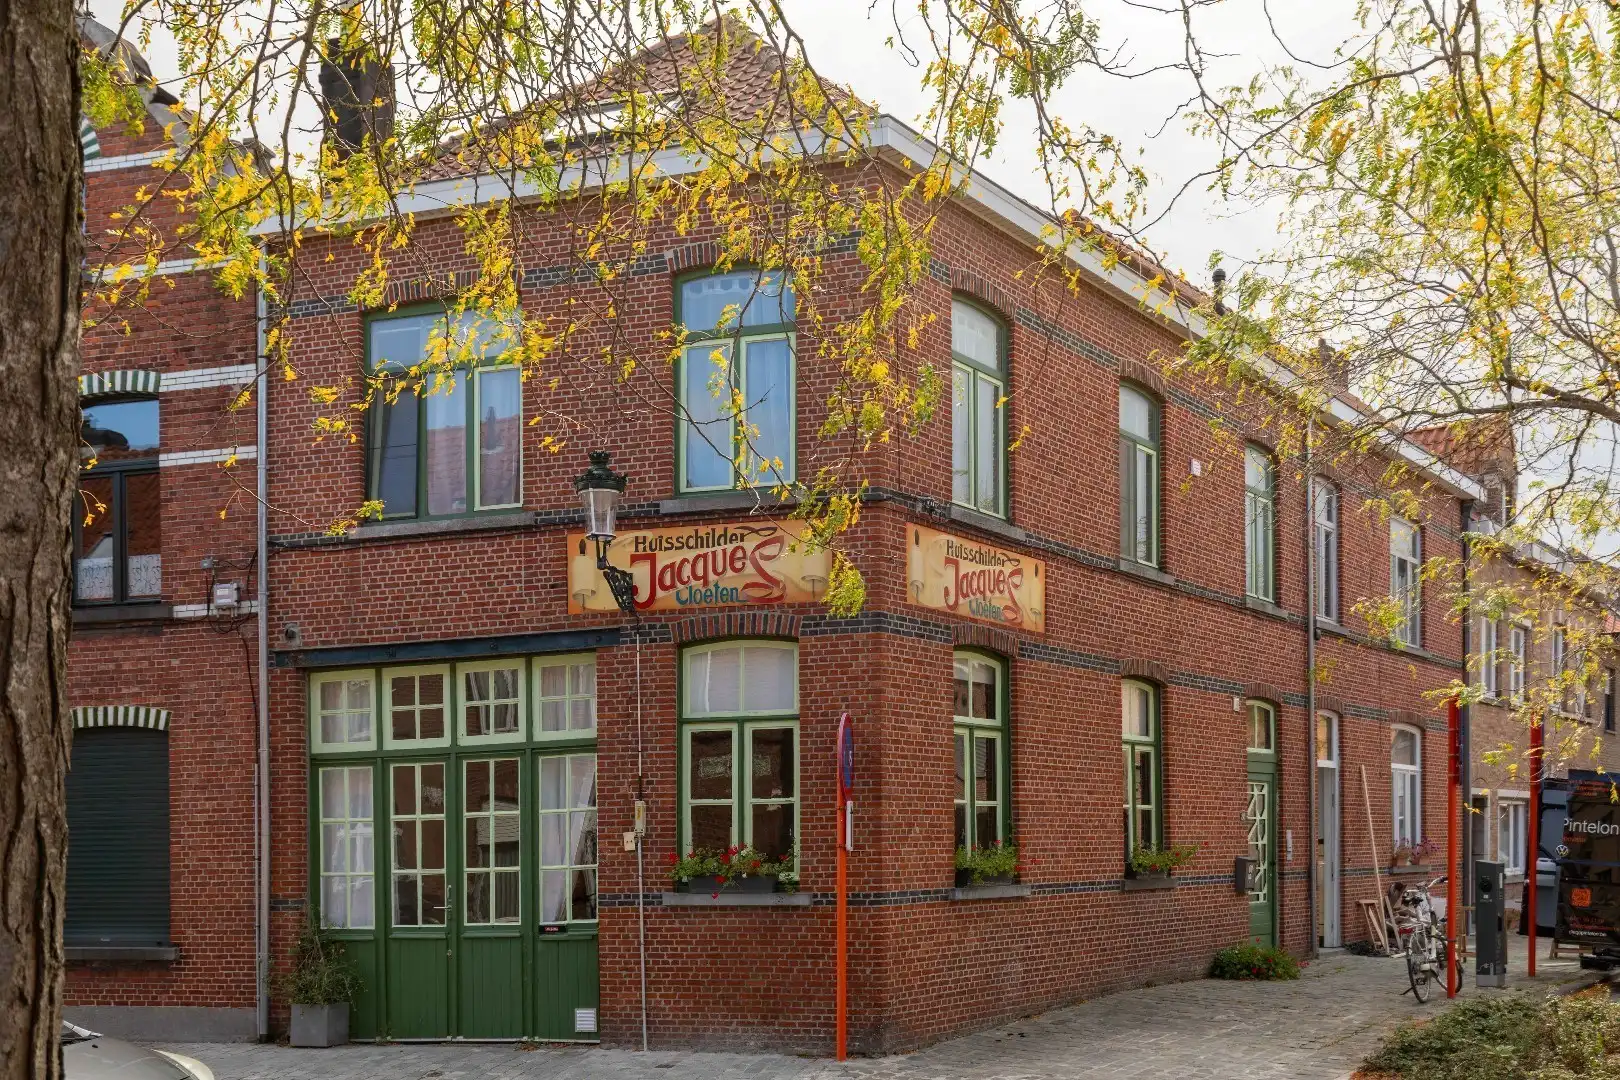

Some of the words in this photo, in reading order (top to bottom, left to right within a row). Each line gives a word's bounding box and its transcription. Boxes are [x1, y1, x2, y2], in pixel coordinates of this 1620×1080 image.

[634, 526, 777, 553] Huisschilder
[946, 539, 1020, 568] Huisschilder
[630, 534, 787, 609] Jacques
[943, 556, 1024, 626] Jacques
[1563, 818, 1619, 836] Pintelon
